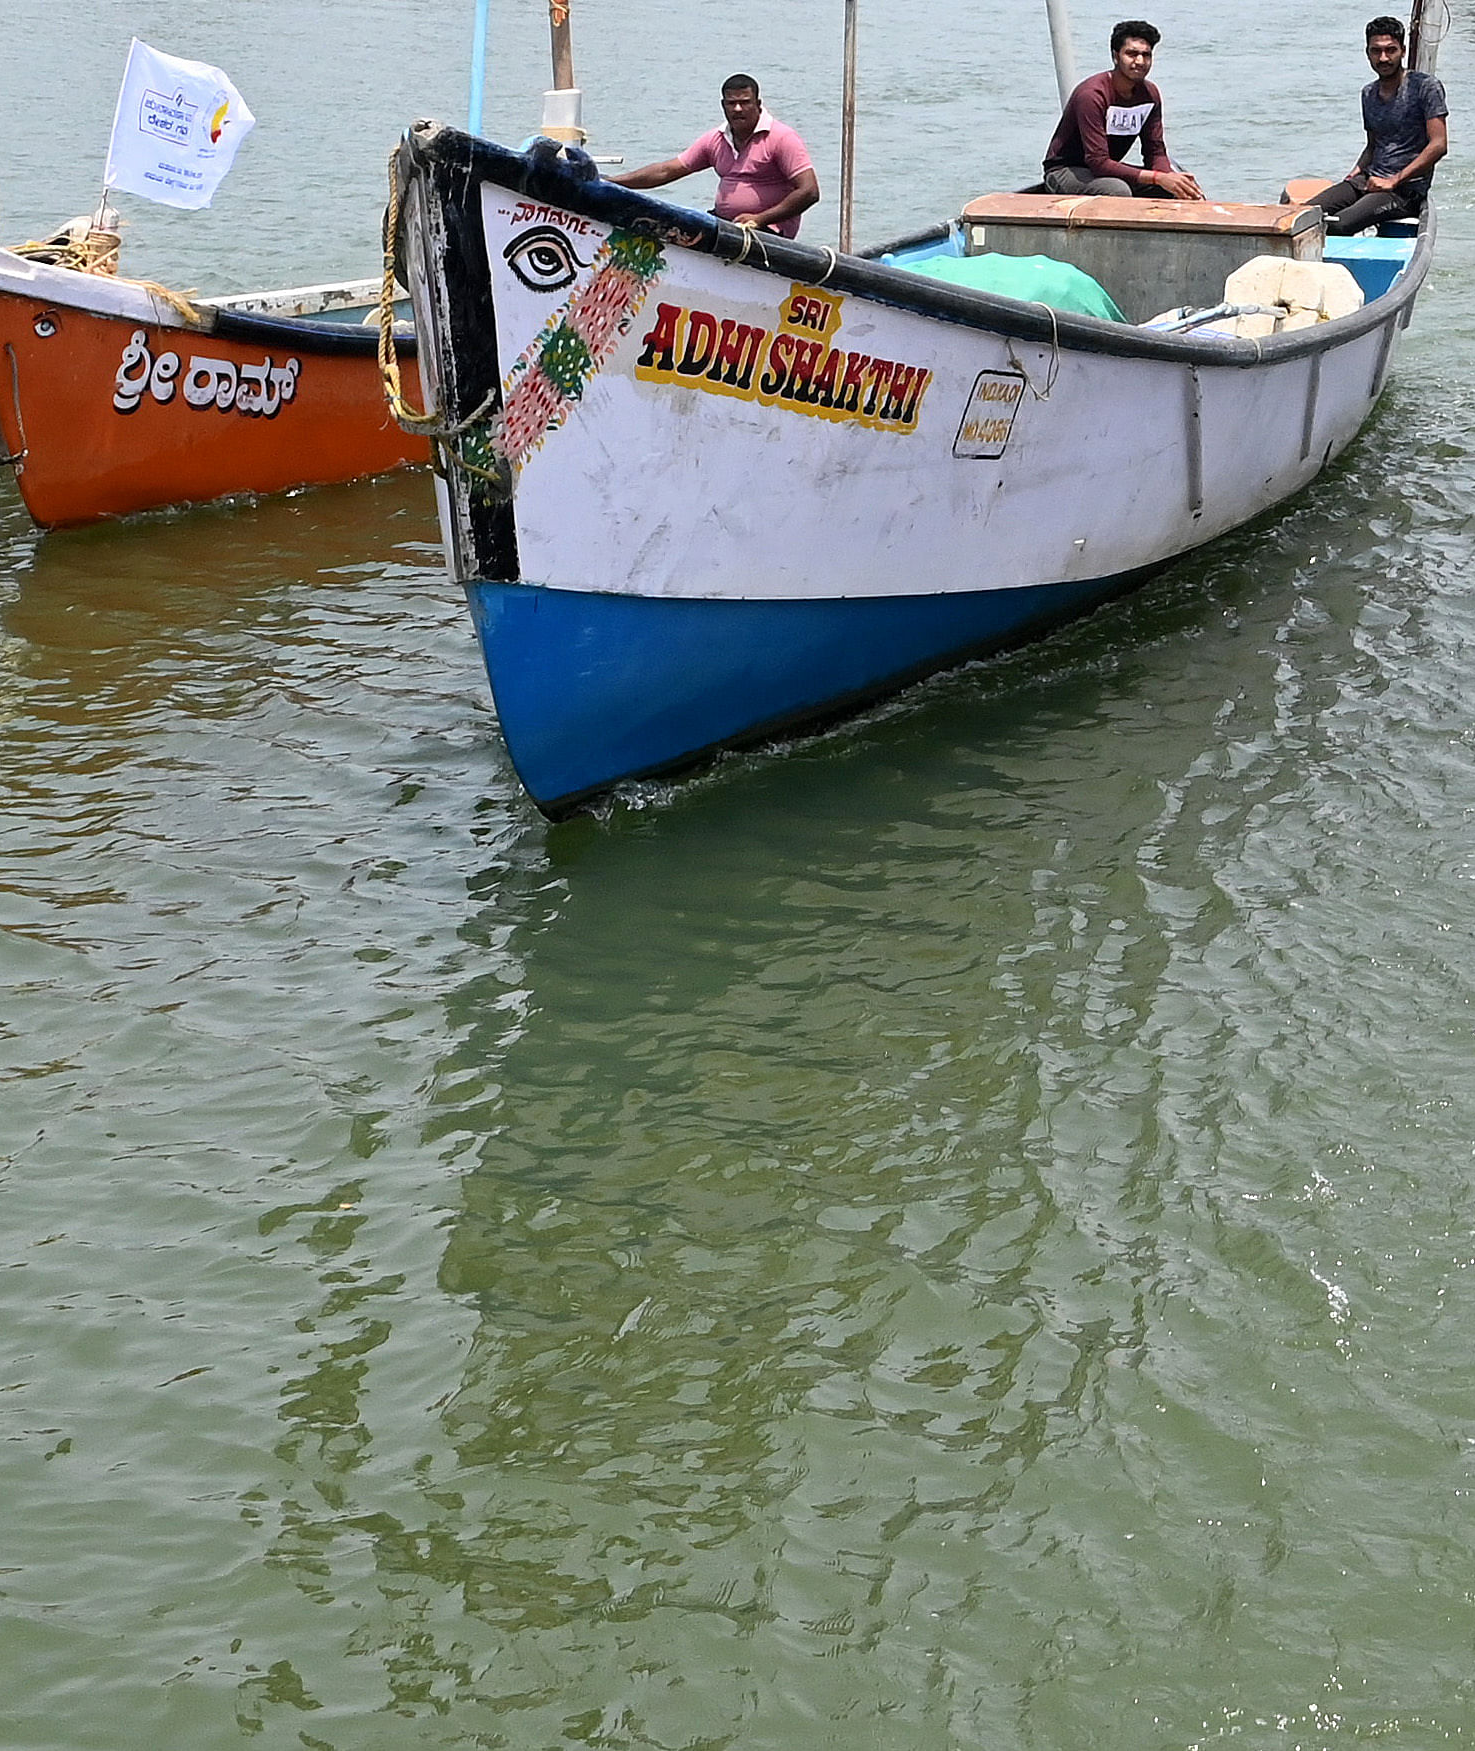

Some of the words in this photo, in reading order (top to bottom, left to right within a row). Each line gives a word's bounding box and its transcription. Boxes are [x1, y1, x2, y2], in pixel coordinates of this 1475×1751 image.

[787, 295, 831, 332] SRI
[113, 329, 181, 414] ಶ್ರೀ
[636, 301, 768, 391] ADHI
[759, 332, 929, 425] SHAKTHI
